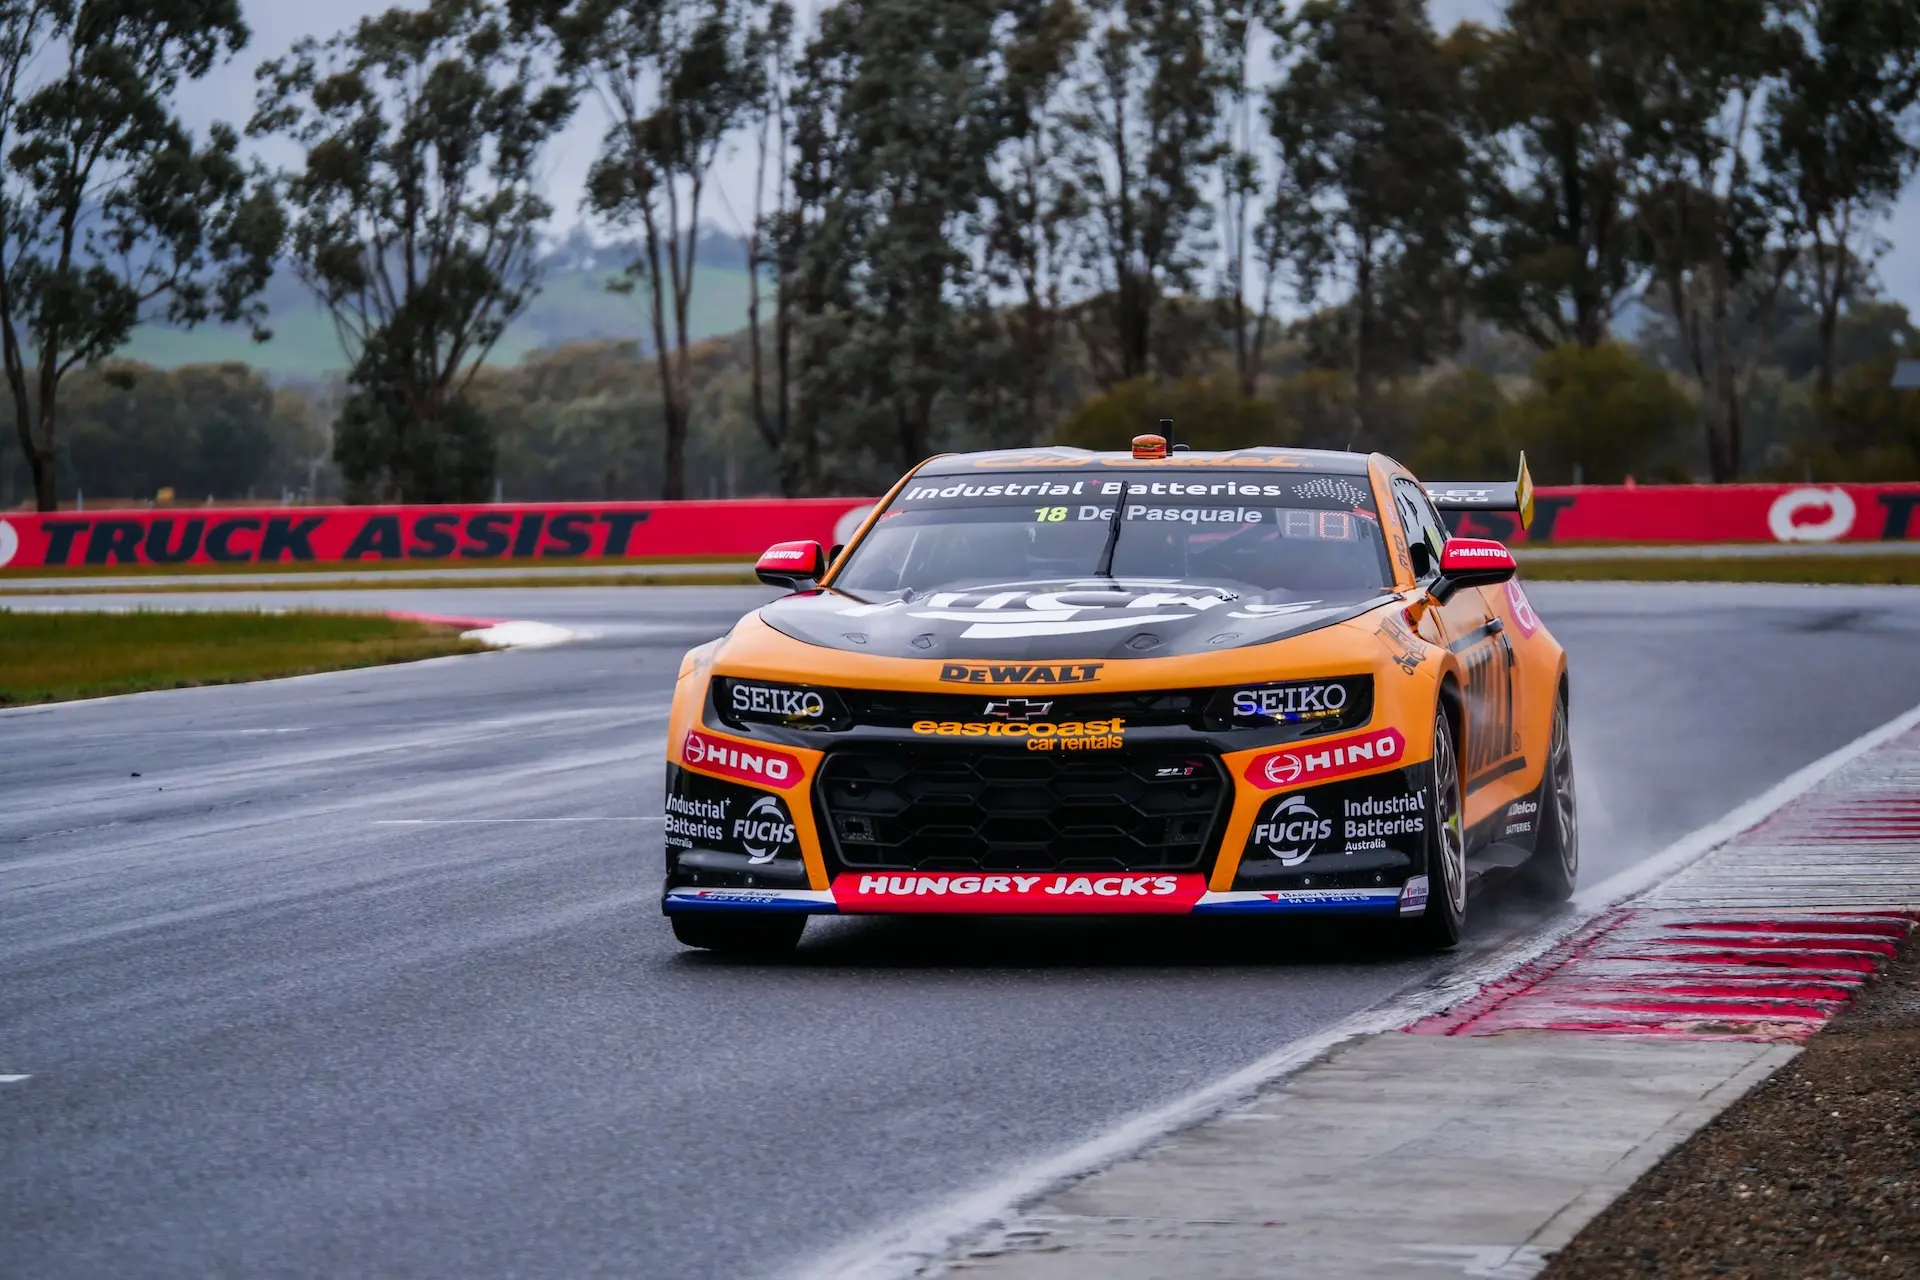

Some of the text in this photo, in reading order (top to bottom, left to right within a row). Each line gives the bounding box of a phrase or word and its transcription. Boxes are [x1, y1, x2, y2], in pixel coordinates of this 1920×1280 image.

[1101, 481, 1281, 496] Batteries
[1033, 505, 1263, 526] 18 De Pasquale
[41, 509, 650, 564] TRUCK ASSIST
[1460, 548, 1508, 558] MANITOU
[732, 684, 824, 717] SEIKO
[1233, 683, 1347, 716] SEIKO
[912, 717, 1126, 737] eastcoast
[1026, 733, 1123, 751] car rentals
[1305, 736, 1396, 772] HINO
[707, 744, 789, 780] HINO
[664, 813, 723, 841] Batteries
[733, 819, 795, 844] FUCHS
[1255, 819, 1332, 844] FUCHS
[1344, 815, 1424, 838] Batteries
[1345, 838, 1386, 851] Australia
[858, 875, 1177, 896] HUNGRY JACK'S
